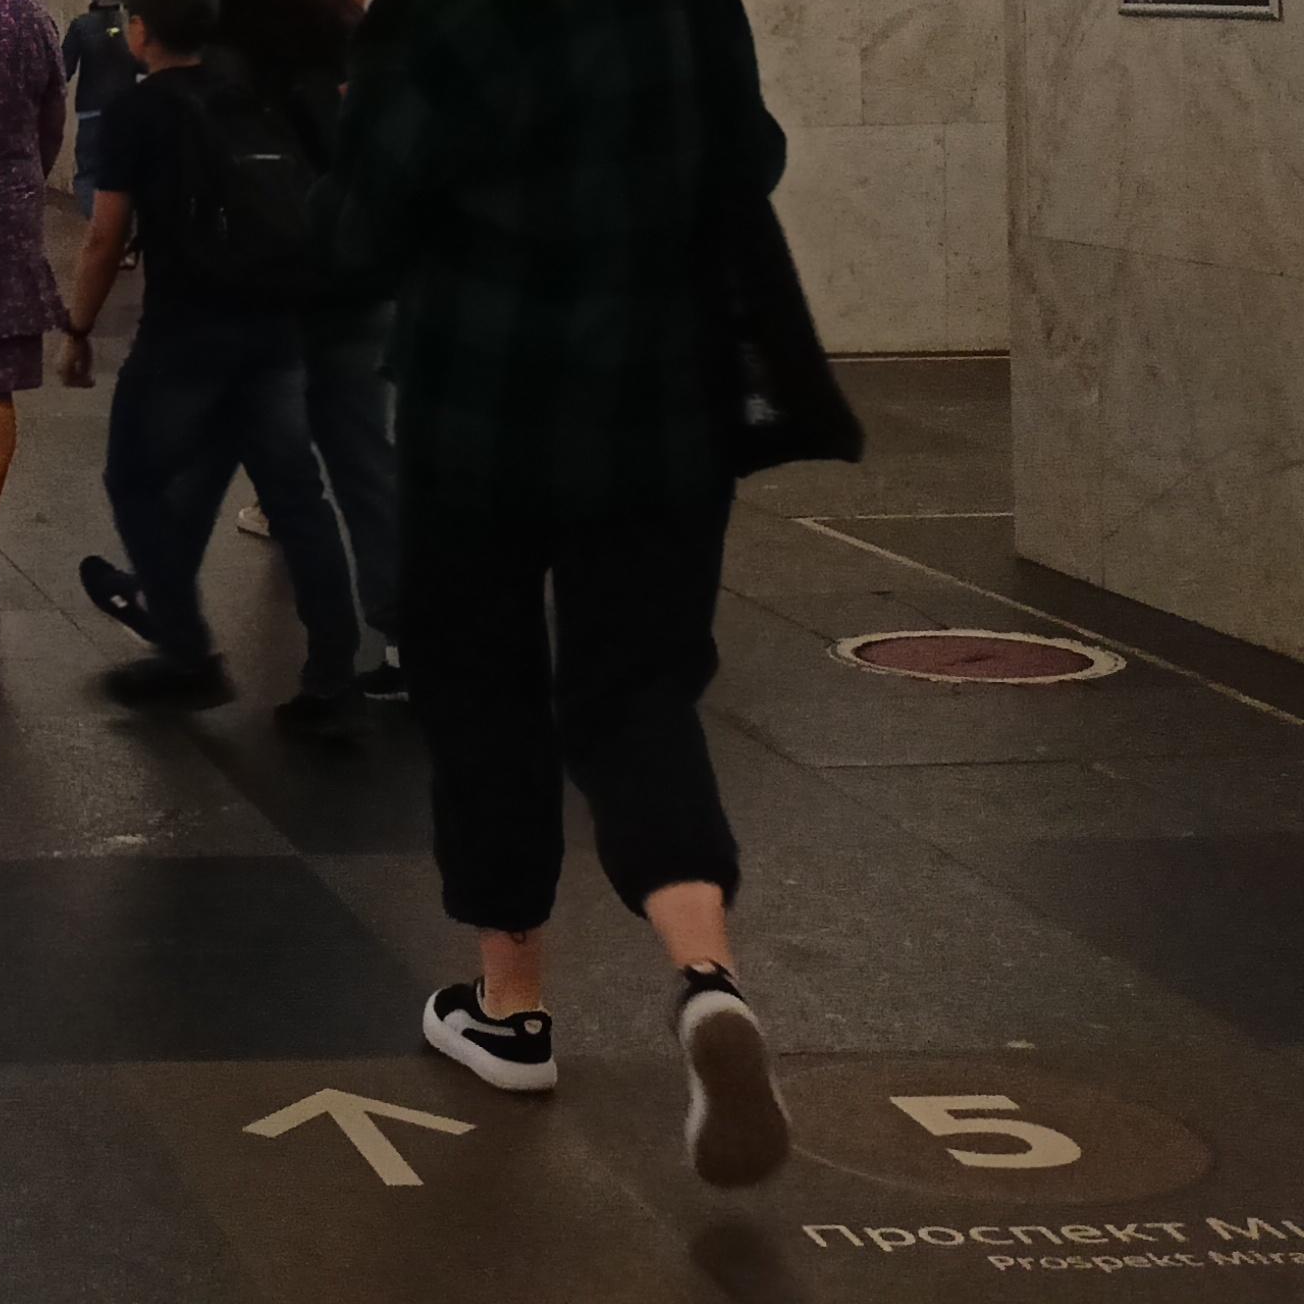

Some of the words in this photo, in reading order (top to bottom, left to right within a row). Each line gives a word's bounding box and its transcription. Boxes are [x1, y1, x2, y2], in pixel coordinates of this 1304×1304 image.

[890, 1095, 1082, 1169] 5
[801, 1221, 1190, 1252] Проспект
[987, 1252, 1205, 1274] Prospekt
